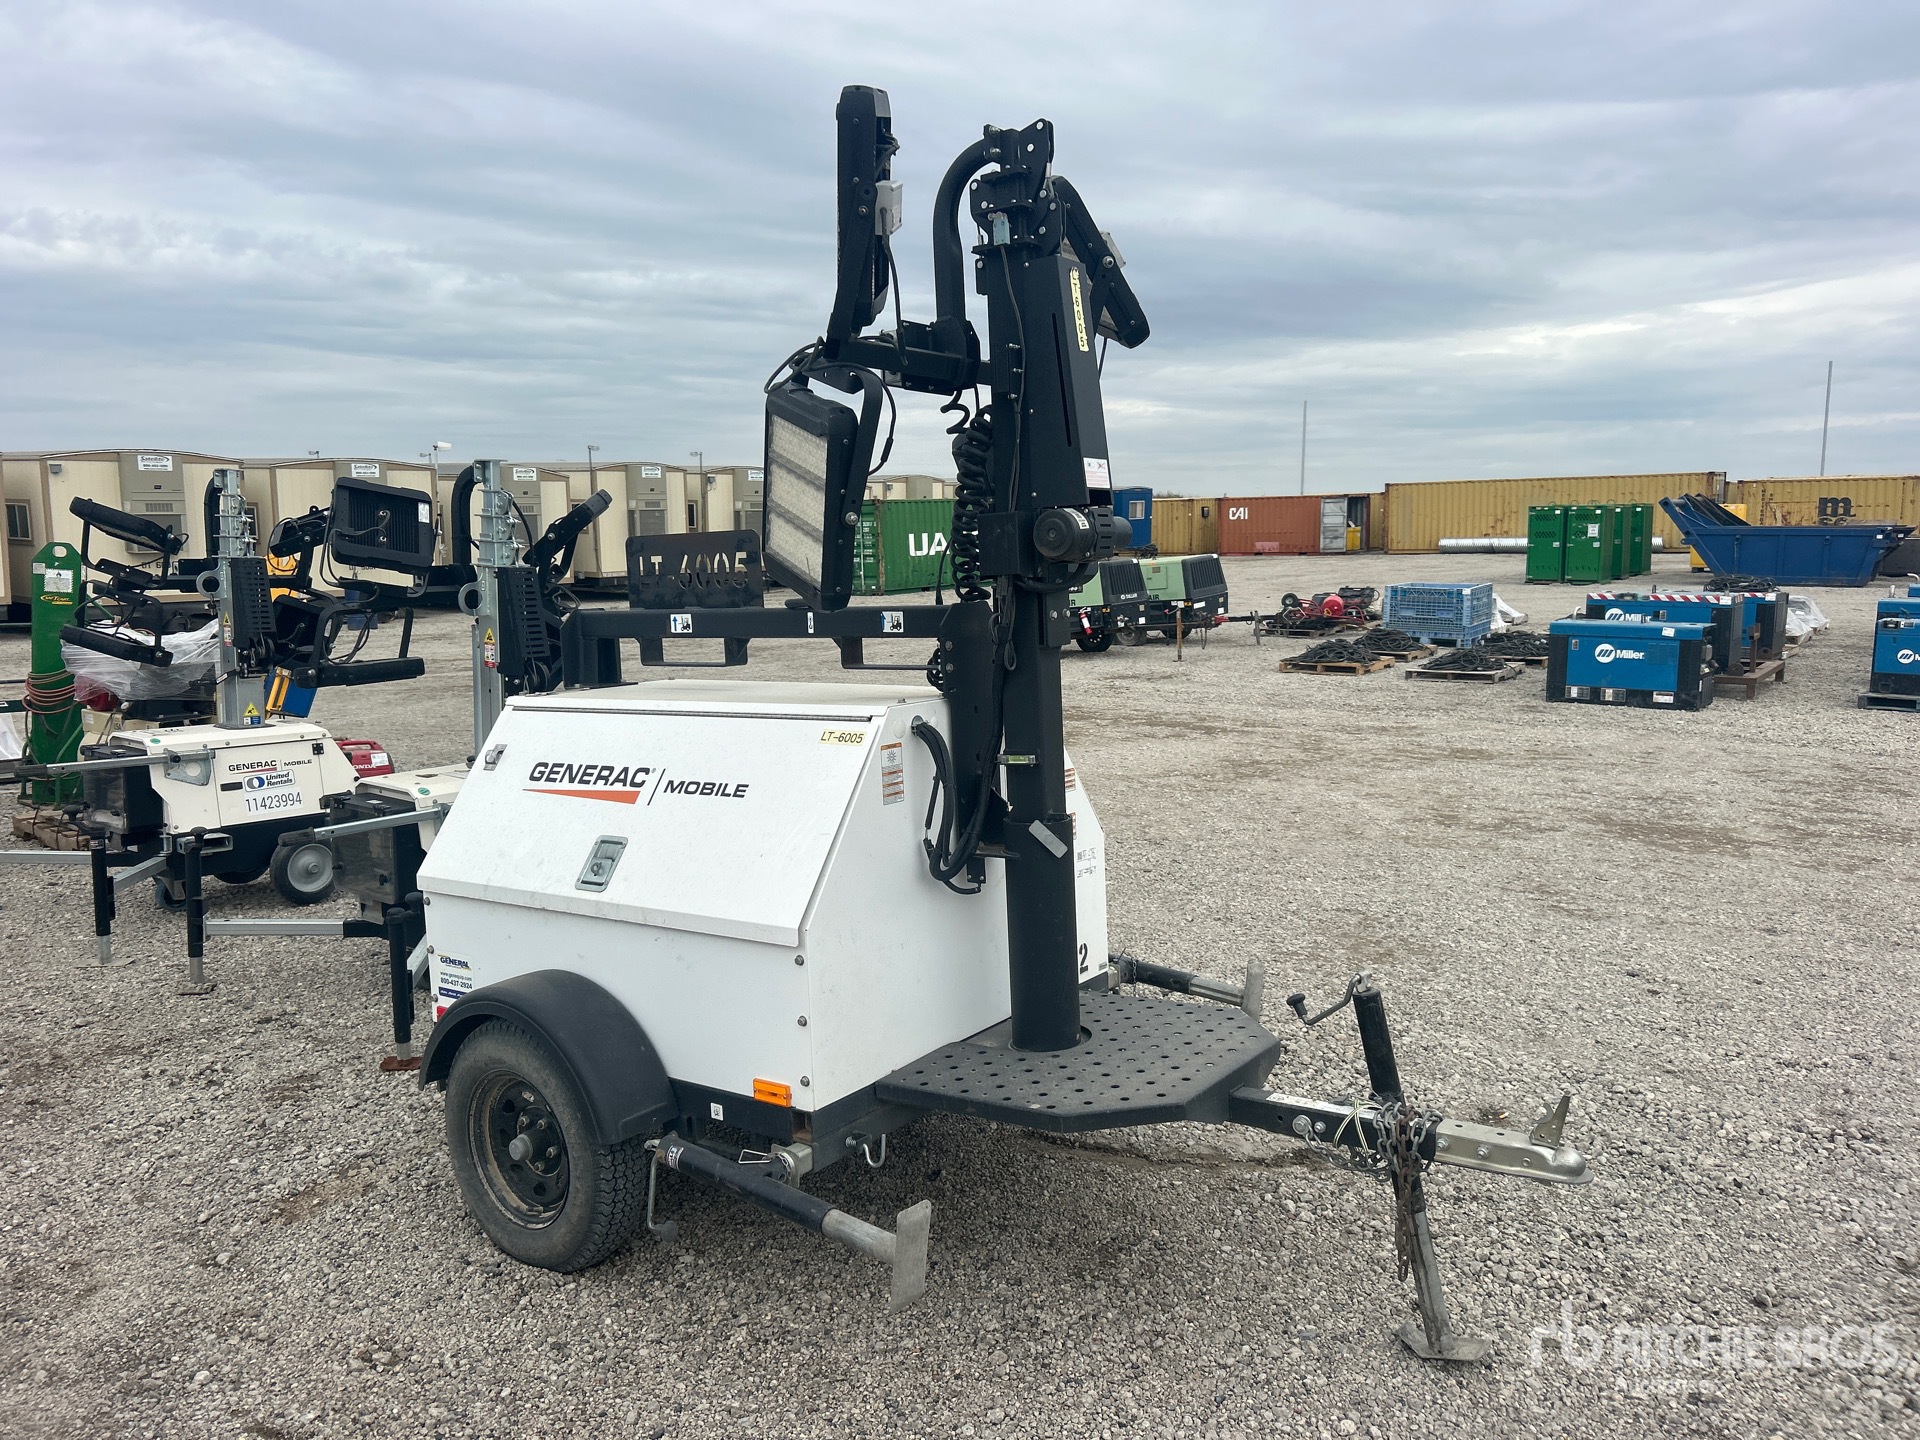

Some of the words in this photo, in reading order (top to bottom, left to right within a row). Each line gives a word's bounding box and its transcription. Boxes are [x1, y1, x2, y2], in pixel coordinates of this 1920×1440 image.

[1229, 507, 1248, 520] CAI
[1616, 649, 1645, 660] Miller
[820, 731, 864, 744] LT-6005
[228, 760, 277, 772] GENERAC
[283, 759, 313, 767] MOBILE
[265, 772, 290, 781] United
[266, 777, 293, 787] Rentals
[528, 762, 650, 789] GENERAC
[663, 779, 750, 799] MOBILE
[245, 791, 302, 812] 11423994
[440, 956, 470, 969] GENERAL
[1079, 943, 1088, 974] 2
[440, 977, 473, 989] 800-437-2924
